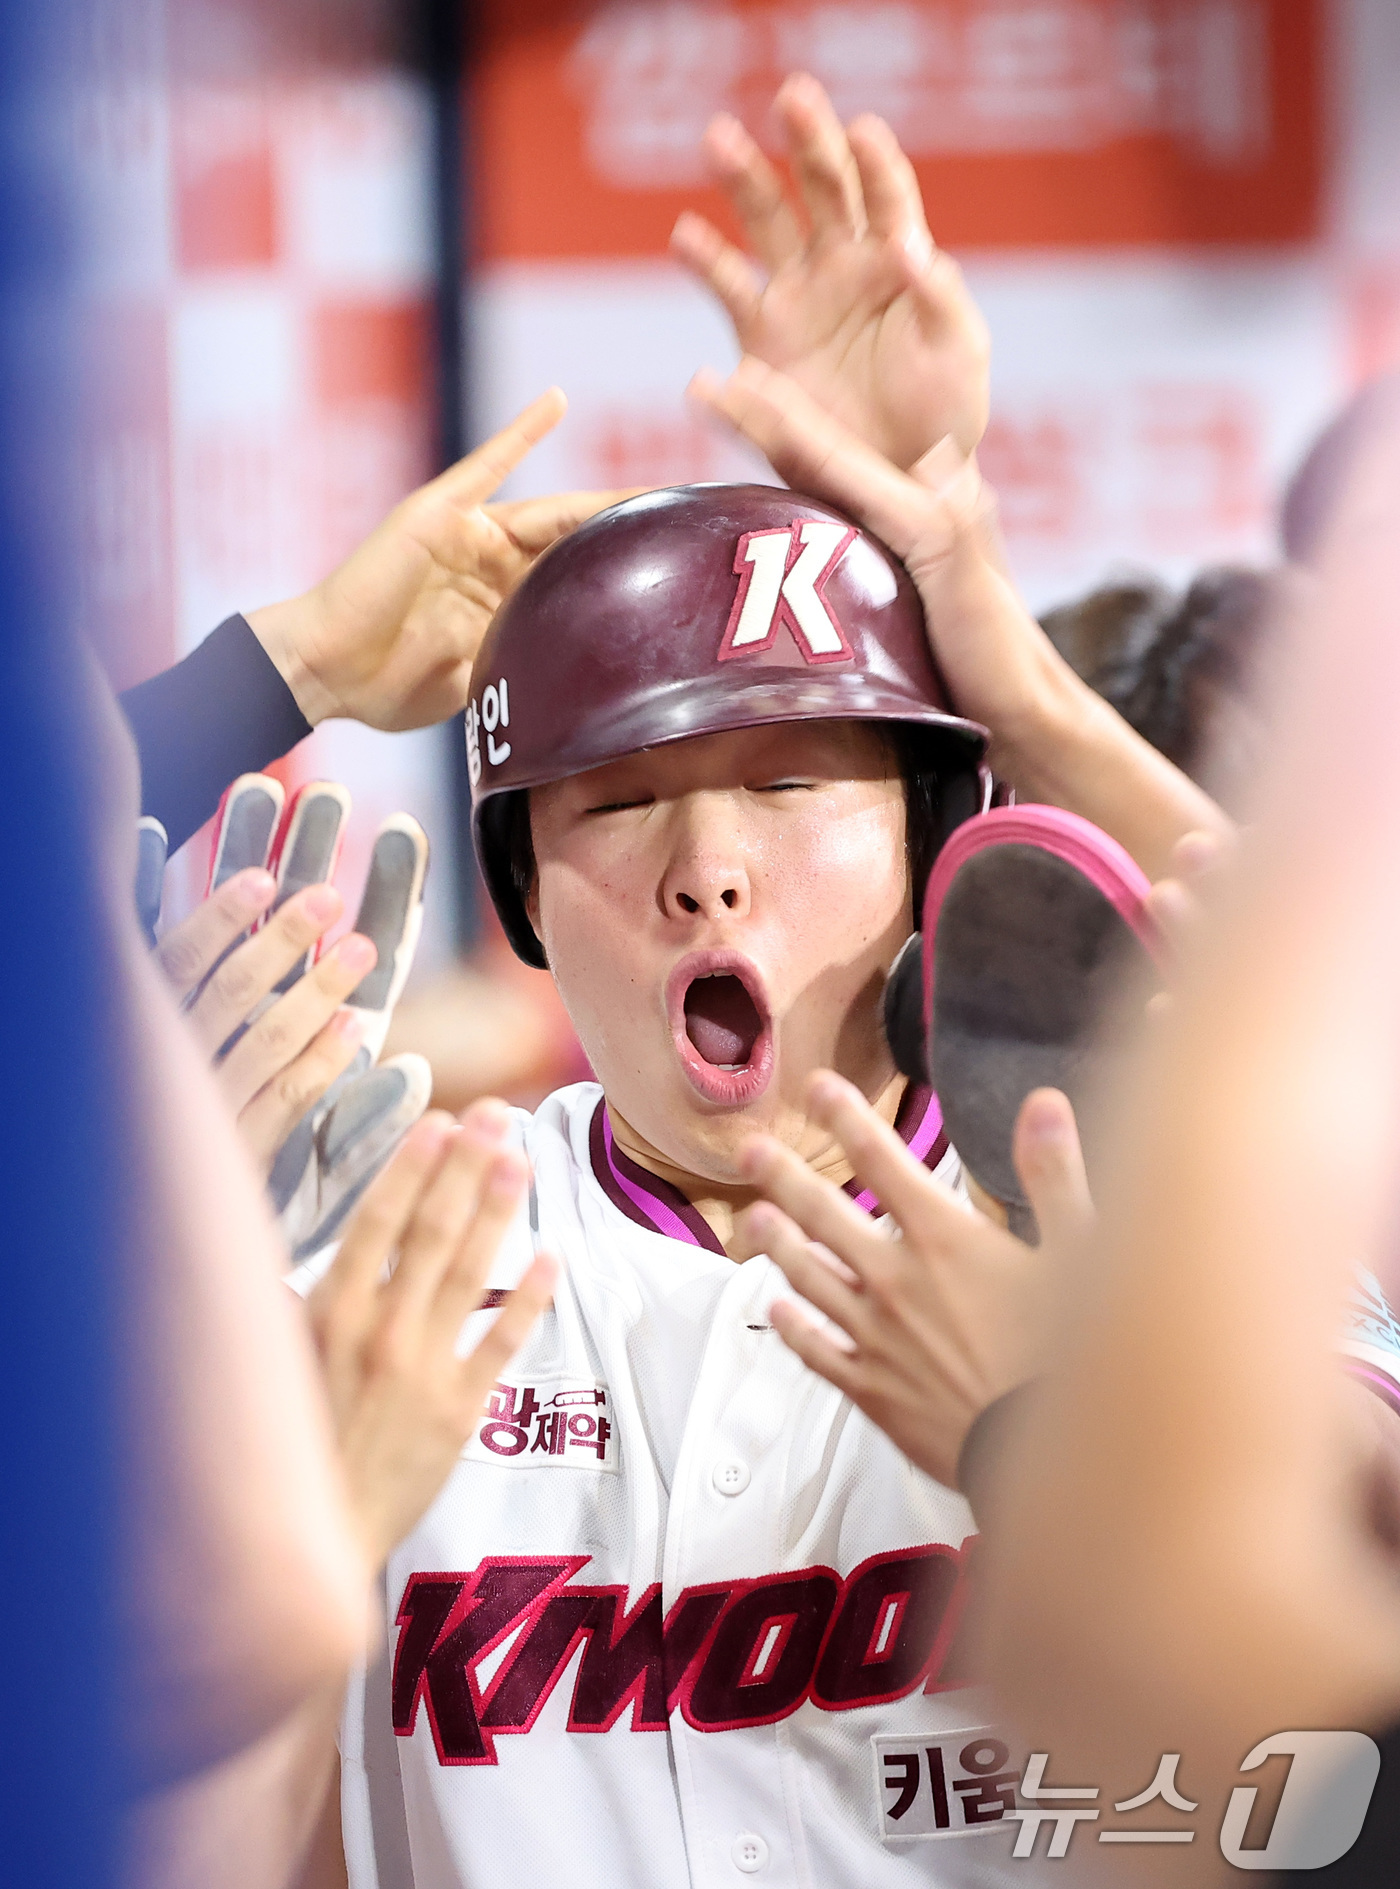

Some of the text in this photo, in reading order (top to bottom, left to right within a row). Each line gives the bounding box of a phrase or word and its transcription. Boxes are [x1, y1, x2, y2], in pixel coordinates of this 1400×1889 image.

[718, 518, 860, 664] K
[391, 1534, 984, 1766] KIWOO
[883, 1738, 1021, 1829] 키움
